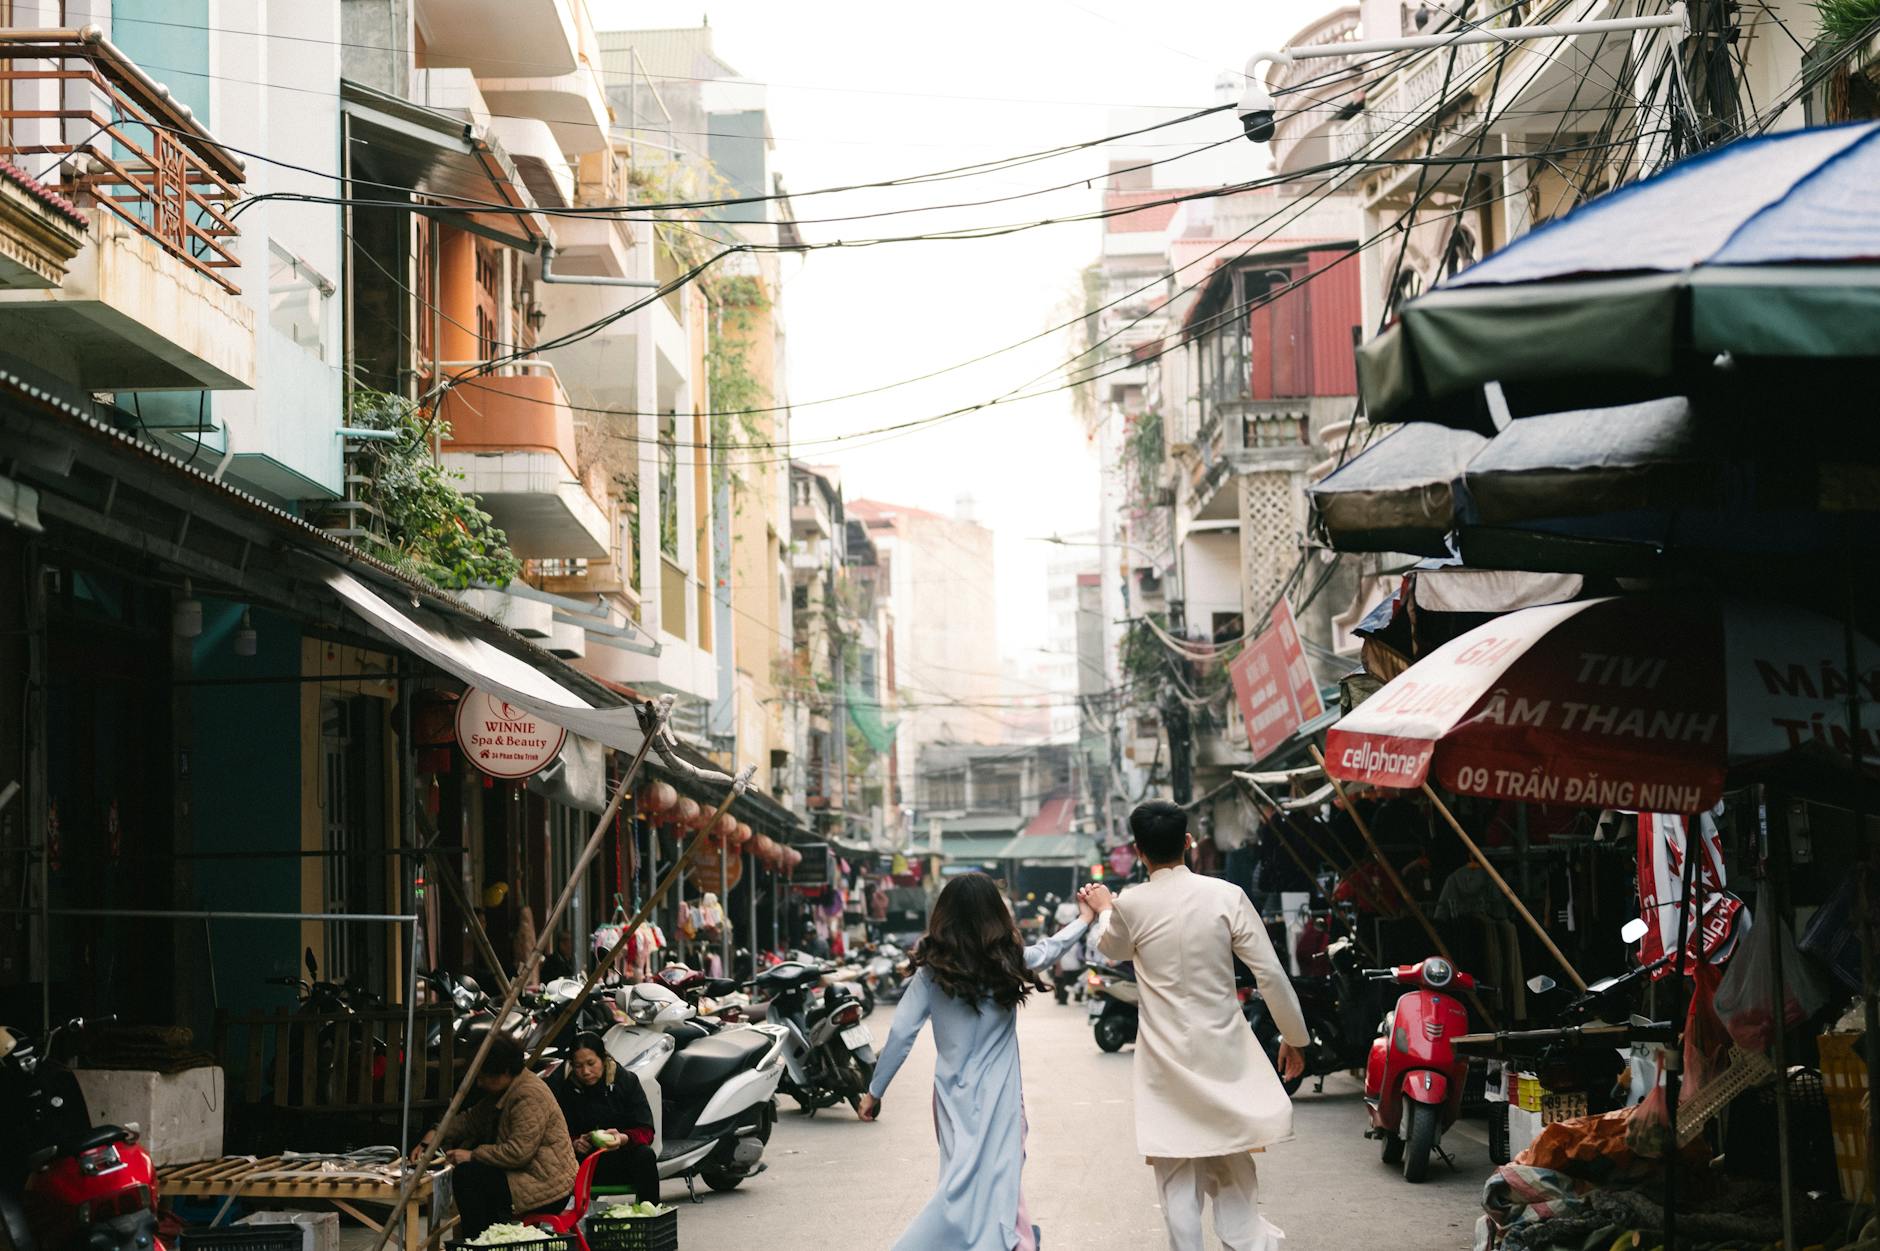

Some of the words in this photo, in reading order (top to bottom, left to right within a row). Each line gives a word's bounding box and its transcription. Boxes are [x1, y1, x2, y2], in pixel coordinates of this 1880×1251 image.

[1455, 637, 1522, 667] GIA
[1576, 652, 1667, 689] TIVI
[485, 721, 536, 734] WINNIE
[1474, 688, 1552, 727] ÂM
[1560, 702, 1719, 743] THANH
[471, 734, 493, 747] Spa
[495, 736, 504, 746] &
[506, 736, 547, 749] Beauty
[1457, 766, 1489, 793] 09
[1494, 765, 1560, 801] TRẦN
[1564, 772, 1635, 809] ĐĂNG
[1639, 783, 1701, 812] NINH
